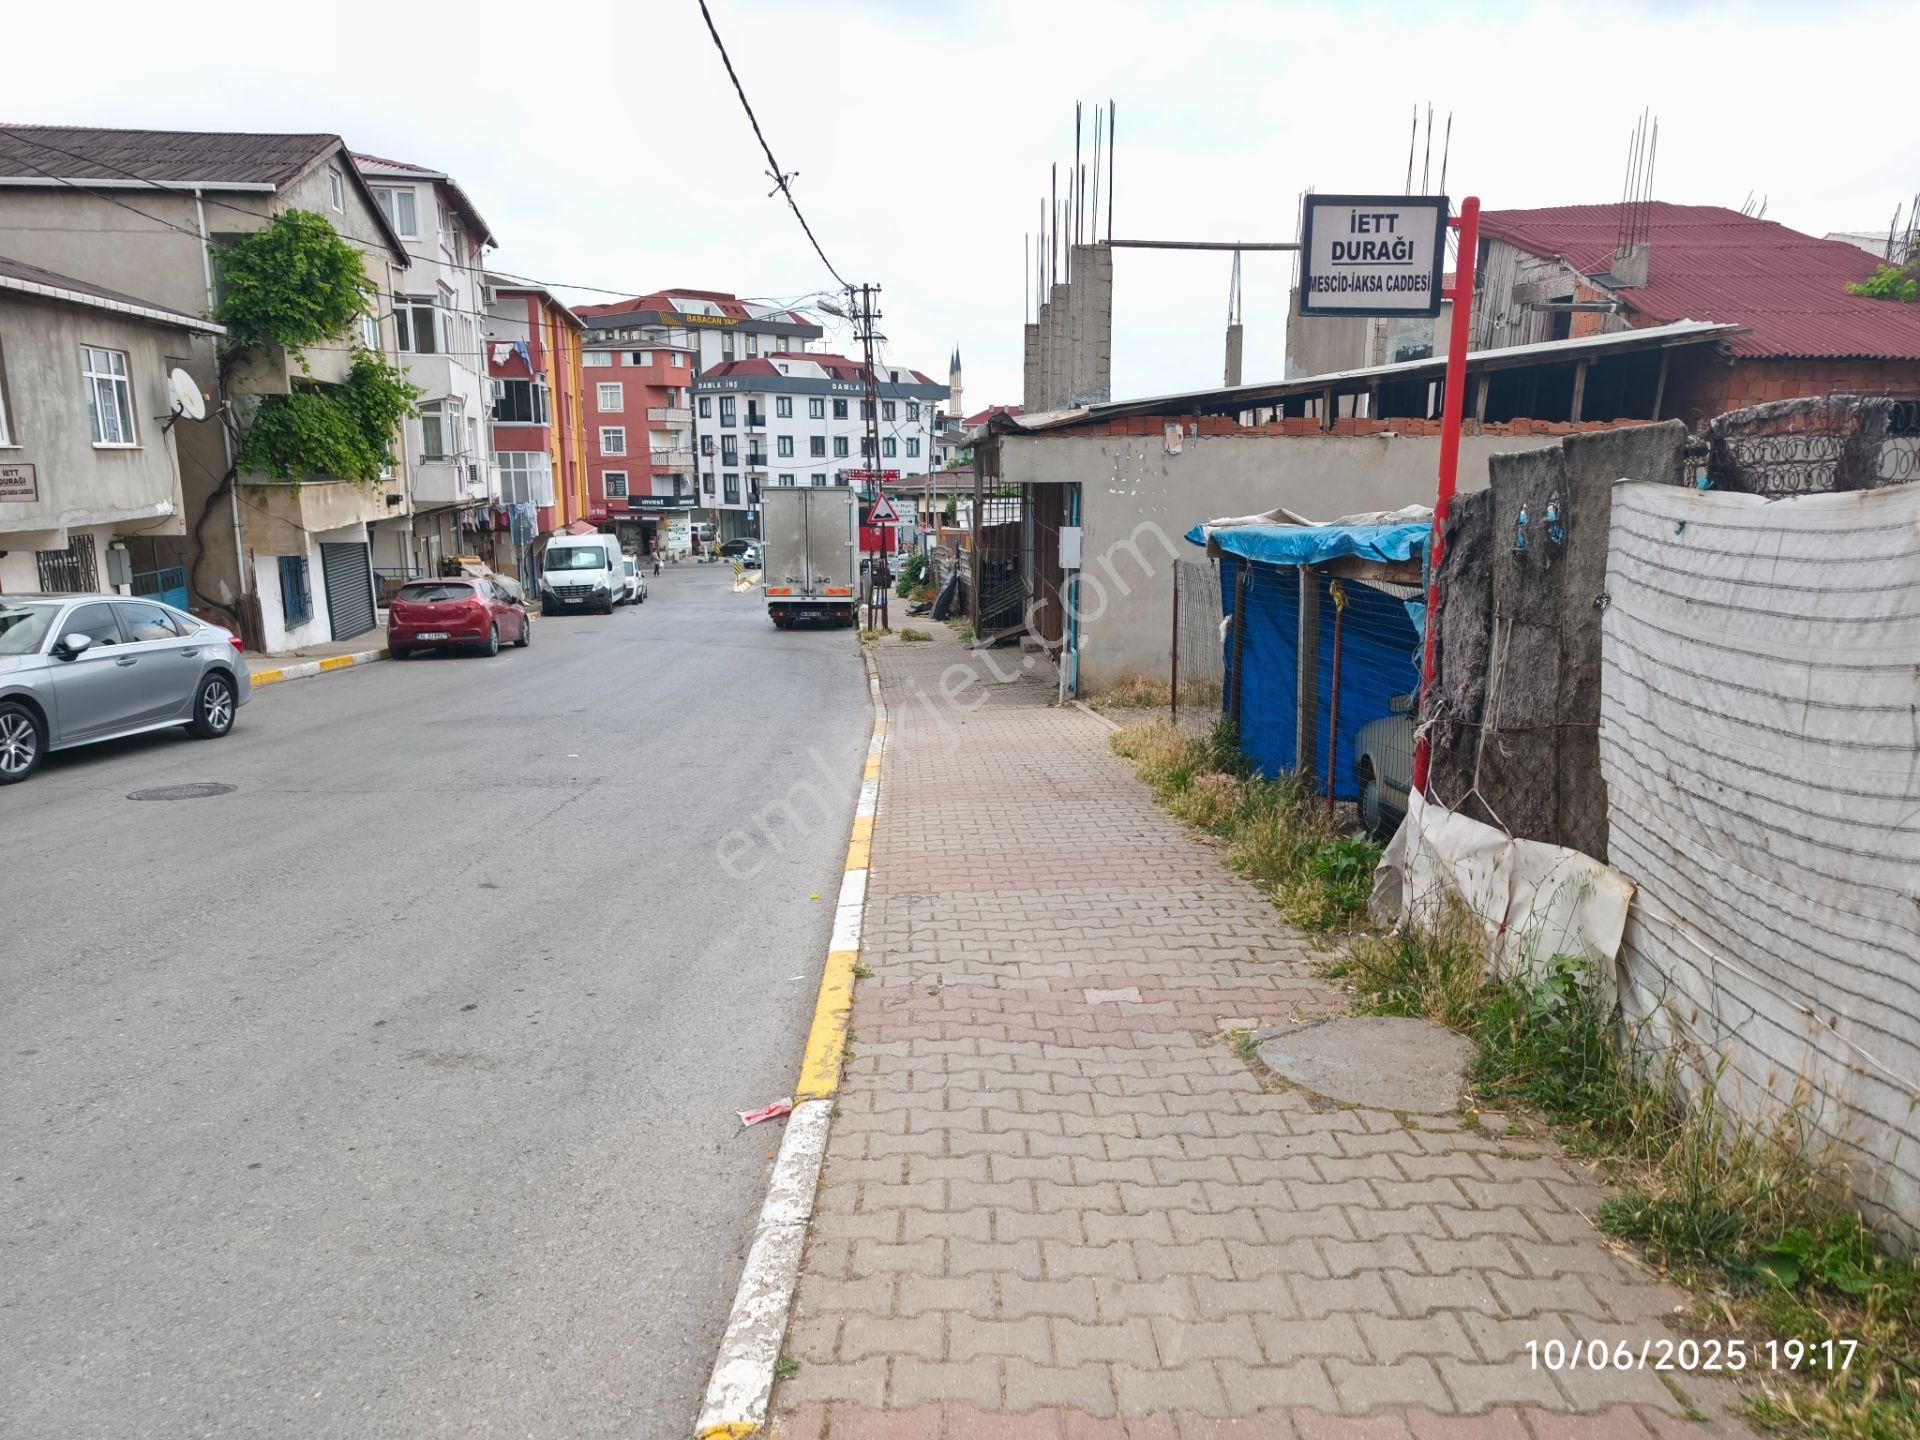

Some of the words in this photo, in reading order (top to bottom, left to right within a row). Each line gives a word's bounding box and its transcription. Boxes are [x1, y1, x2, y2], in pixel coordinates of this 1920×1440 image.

[1350, 209, 1399, 233] İETT
[1332, 236, 1414, 261] DURAĞI
[1309, 272, 1383, 293] MESCİD-İAKSA
[1386, 270, 1431, 292] CADDESİ
[686, 314, 722, 325] BABACAN
[832, 383, 860, 391] DAMLA
